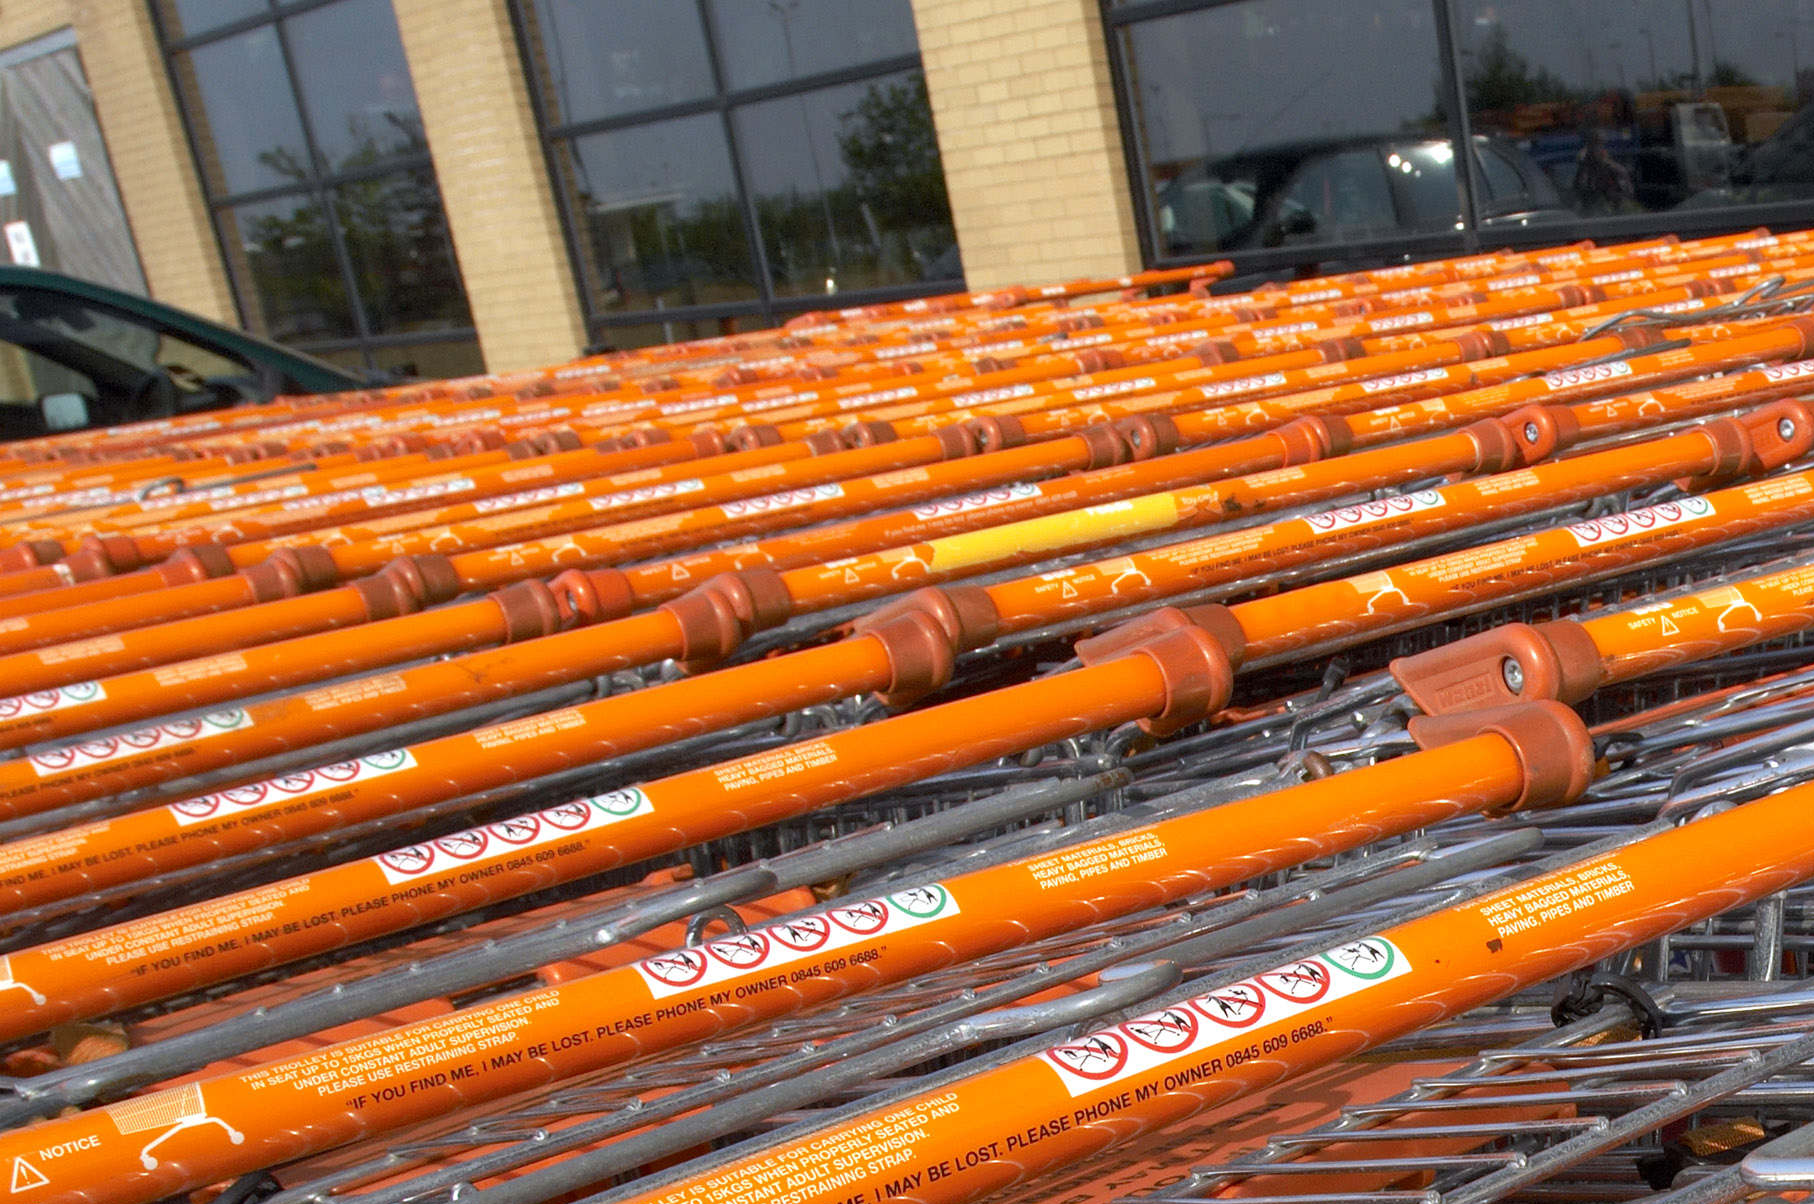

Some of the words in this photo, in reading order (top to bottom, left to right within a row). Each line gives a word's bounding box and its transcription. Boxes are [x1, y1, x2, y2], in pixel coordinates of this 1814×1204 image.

[1627, 617, 1655, 629] SAFETY
[1671, 606, 1698, 618] NOTICE
[759, 768, 784, 780] PIPES
[786, 763, 804, 773] AND
[805, 754, 837, 767] TIMBER
[1480, 898, 1515, 915] SHEET
[1487, 907, 1523, 926] HEAVY
[1524, 891, 1569, 912] BAGGED
[1540, 903, 1571, 921] PIPES
[1572, 895, 1594, 910] AND
[1594, 880, 1634, 901] TIMBER
[371, 1085, 405, 1103] YOU
[410, 1073, 446, 1092] FIND
[450, 1064, 478, 1080] ME,
[482, 1061, 487, 1071] I
[491, 1051, 521, 1069] MAY
[527, 1043, 547, 1058] BE
[551, 1031, 592, 1051] LOST.
[596, 1013, 652, 1038] PLEASE
[656, 998, 706, 1020] PHONE
[709, 991, 730, 1005] MY
[735, 975, 787, 998] OWNER
[791, 965, 821, 982] 0845
[824, 958, 846, 973] 609
[875, 1188, 880, 1202] I
[885, 1172, 920, 1197] MAY
[927, 1161, 951, 1182] BE
[955, 1142, 1002, 1171] LOST.
[1006, 1116, 1070, 1150] PLEASE
[1074, 1092, 1131, 1124] PHONE
[1135, 1081, 1157, 1102] MY
[1164, 1059, 1222, 1090] OWNER
[1226, 1045, 1260, 1067] 0845
[1263, 1034, 1287, 1053] 609
[39, 1135, 100, 1160] NOTICE
[786, 1163, 829, 1188] ADULT
[833, 1129, 929, 1169] SUPERVISION.
[868, 1148, 915, 1173] STRAP.
